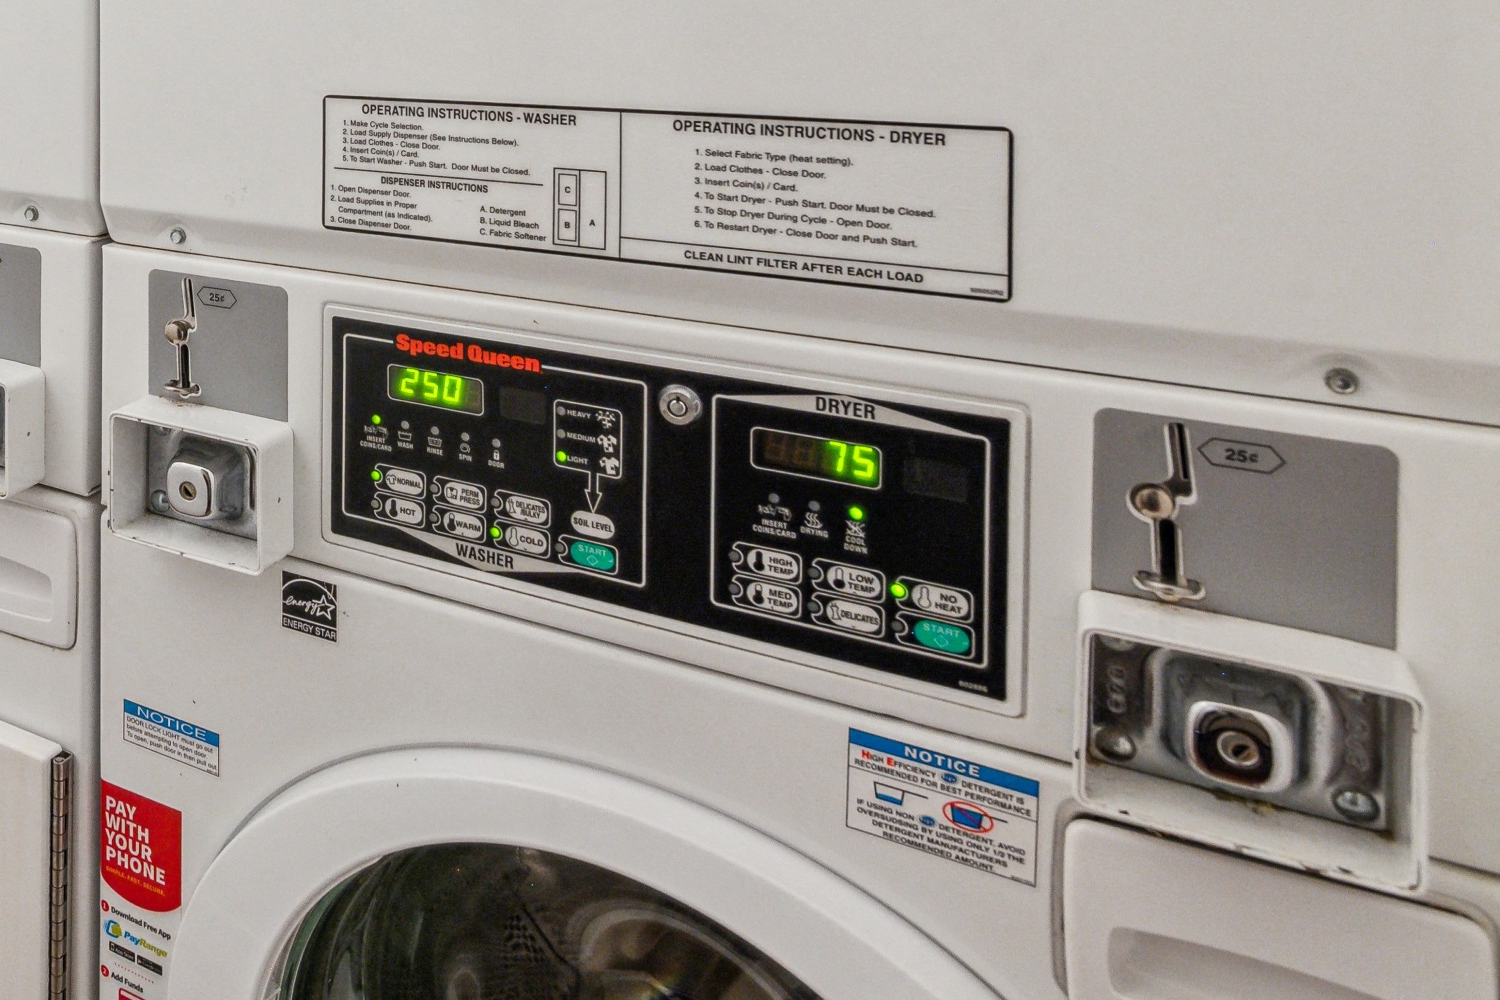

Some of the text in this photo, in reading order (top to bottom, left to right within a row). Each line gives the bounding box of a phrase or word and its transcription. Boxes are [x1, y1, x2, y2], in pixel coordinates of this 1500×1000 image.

[361, 104, 577, 126] OPERATING INSTRUCTIONS WASHER
[672, 119, 946, 146] OPERATING INSTRUCTIONS DRYER
[705, 148, 854, 168] Select Fabric Type (heat setting).
[381, 176, 488, 193] DISPENSER INSTRUCTIONS
[684, 250, 924, 283] CLEAN LINT FILTER AFTER EACH LOAD
[209, 293, 225, 302] 25¢
[396, 333, 540, 373] Speed Queen
[399, 368, 462, 403] 250
[566, 408, 591, 420] HEAVY
[815, 396, 876, 420] DRYER
[366, 435, 385, 444] INSERT
[566, 431, 596, 443] MEDIUM
[360, 442, 392, 452] COINS/CARD
[397, 440, 414, 450] WASH
[427, 446, 443, 456] RINSE
[458, 452, 472, 462] SPIN
[488, 459, 505, 469] DOOR
[567, 455, 588, 466] LIGHT
[829, 440, 875, 478] 75
[1224, 448, 1259, 466] 25¢
[396, 476, 422, 490] NORMAL
[461, 488, 480, 499] PERM
[459, 495, 481, 507] PRESS
[515, 501, 546, 515] DELICATES
[400, 506, 416, 517] HOT
[455, 520, 481, 533] WARM
[573, 516, 613, 533] SOIL LEVEL
[800, 527, 829, 539] DRYING
[519, 535, 544, 548] COLD
[845, 535, 866, 546] COOL
[455, 542, 514, 570] WASHER
[578, 544, 607, 557] START
[844, 543, 868, 555] DOWN
[769, 556, 793, 568] HIGH
[767, 565, 794, 577] TEMP
[849, 573, 874, 585] LOW
[769, 589, 792, 600] MED
[848, 582, 875, 595] TEMP
[767, 598, 794, 610] TEMP
[940, 592, 958, 603] NO
[935, 602, 963, 614] HEAT
[840, 609, 879, 626] DELICATES
[283, 617, 336, 640] ENERGY STAR
[923, 622, 961, 639] START
[137, 705, 207, 741] NOTICE
[903, 746, 981, 778] NOTICE
[854, 758, 1031, 817] RECOMMENDED FOR BEST PERFORMANCE
[962, 780, 1014, 801] DETERGENT
[1016, 795, 1024, 805] IS
[105, 795, 137, 820] PAY
[105, 811, 149, 844] WITH
[105, 828, 152, 862] YOUR
[105, 845, 166, 885] PHONE
[111, 906, 171, 940] Download Free App
[123, 930, 168, 958] PayRange
[111, 971, 144, 993] Add Funds
